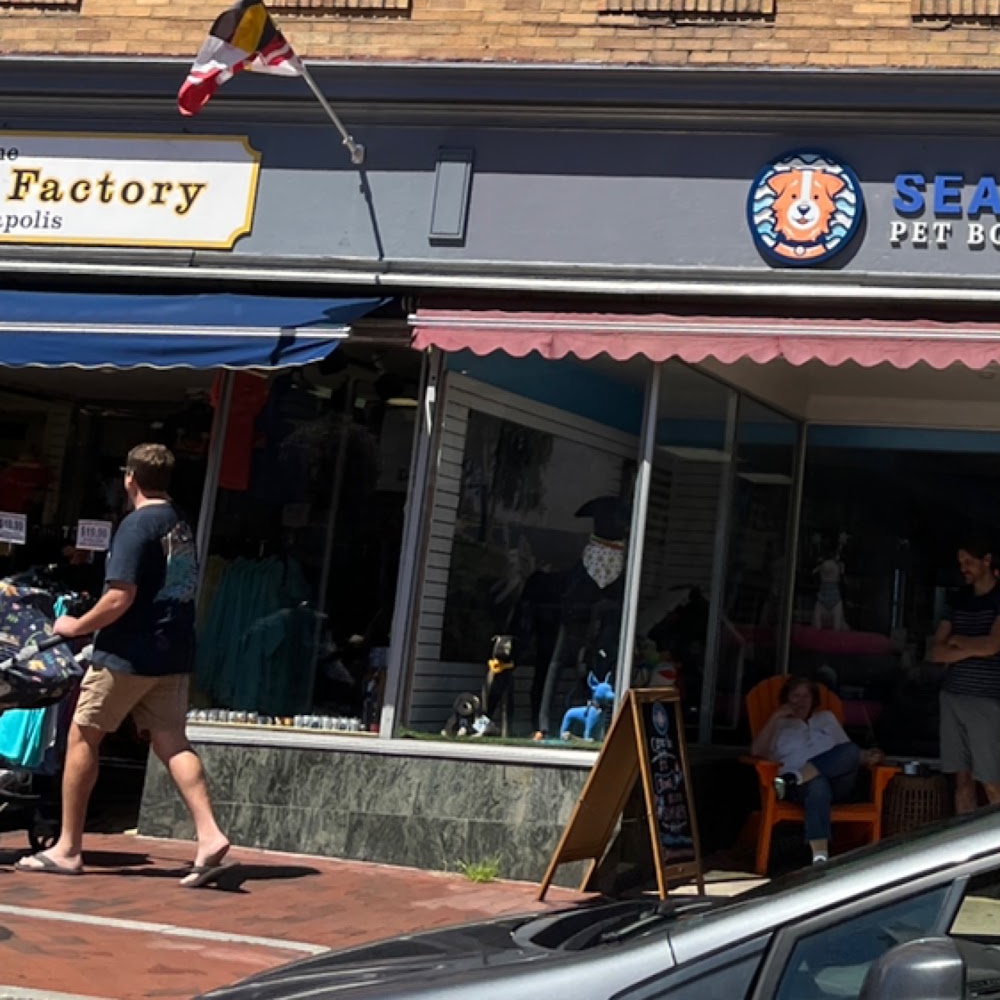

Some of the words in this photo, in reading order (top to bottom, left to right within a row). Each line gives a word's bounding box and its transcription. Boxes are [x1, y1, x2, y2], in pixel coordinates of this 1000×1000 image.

[8, 167, 206, 214] Factory
[0, 210, 63, 232] polis
[889, 221, 952, 244] PET
